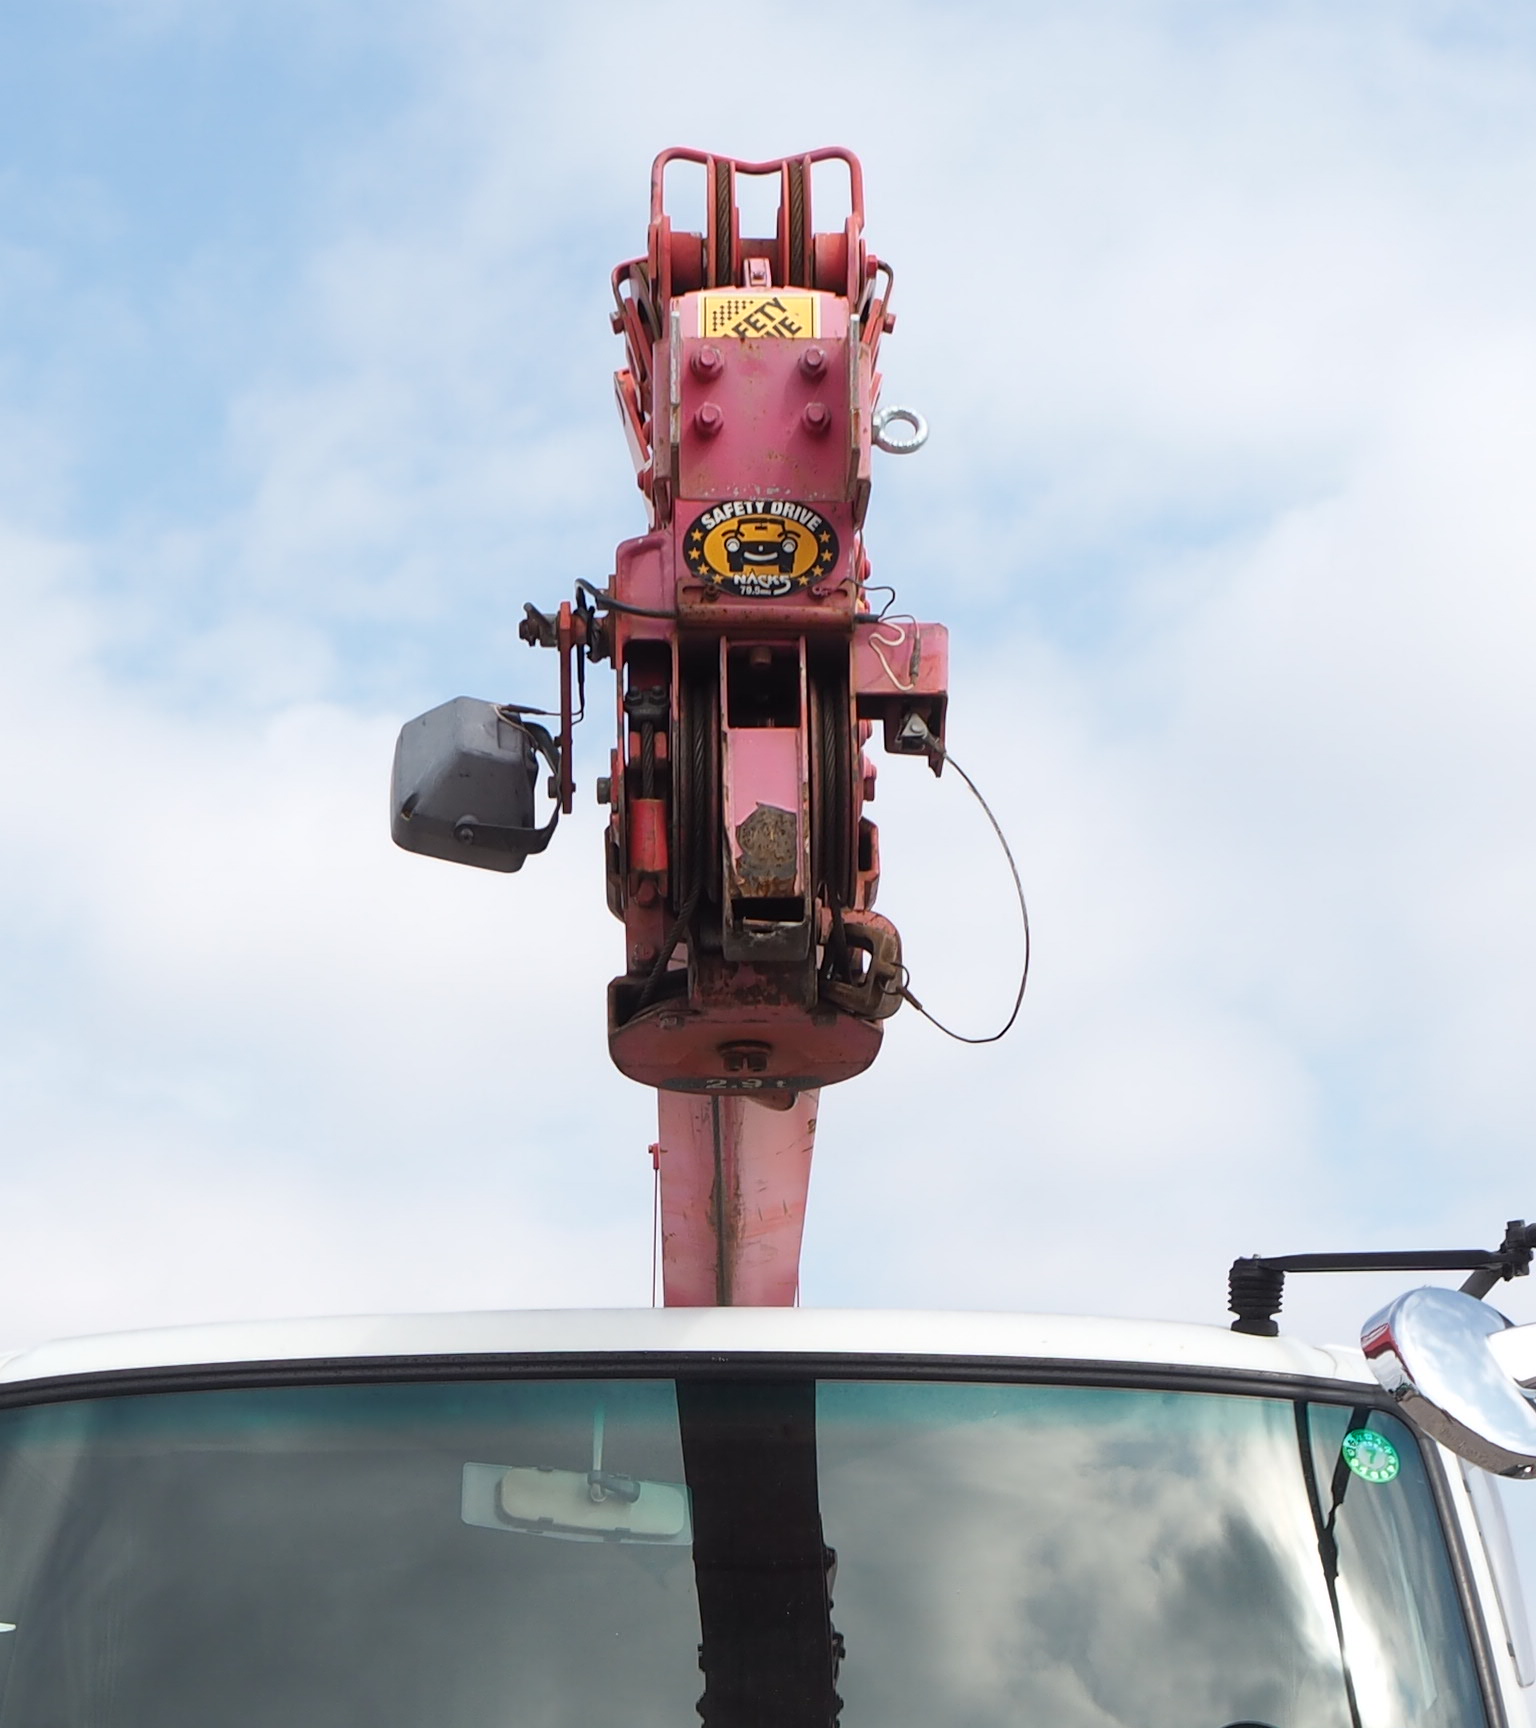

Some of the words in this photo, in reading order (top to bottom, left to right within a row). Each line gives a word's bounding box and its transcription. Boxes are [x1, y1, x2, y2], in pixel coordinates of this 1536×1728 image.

[701, 501, 764, 530] SAFETY
[770, 501, 823, 531] DRIVE
[733, 570, 791, 596] NACK5
